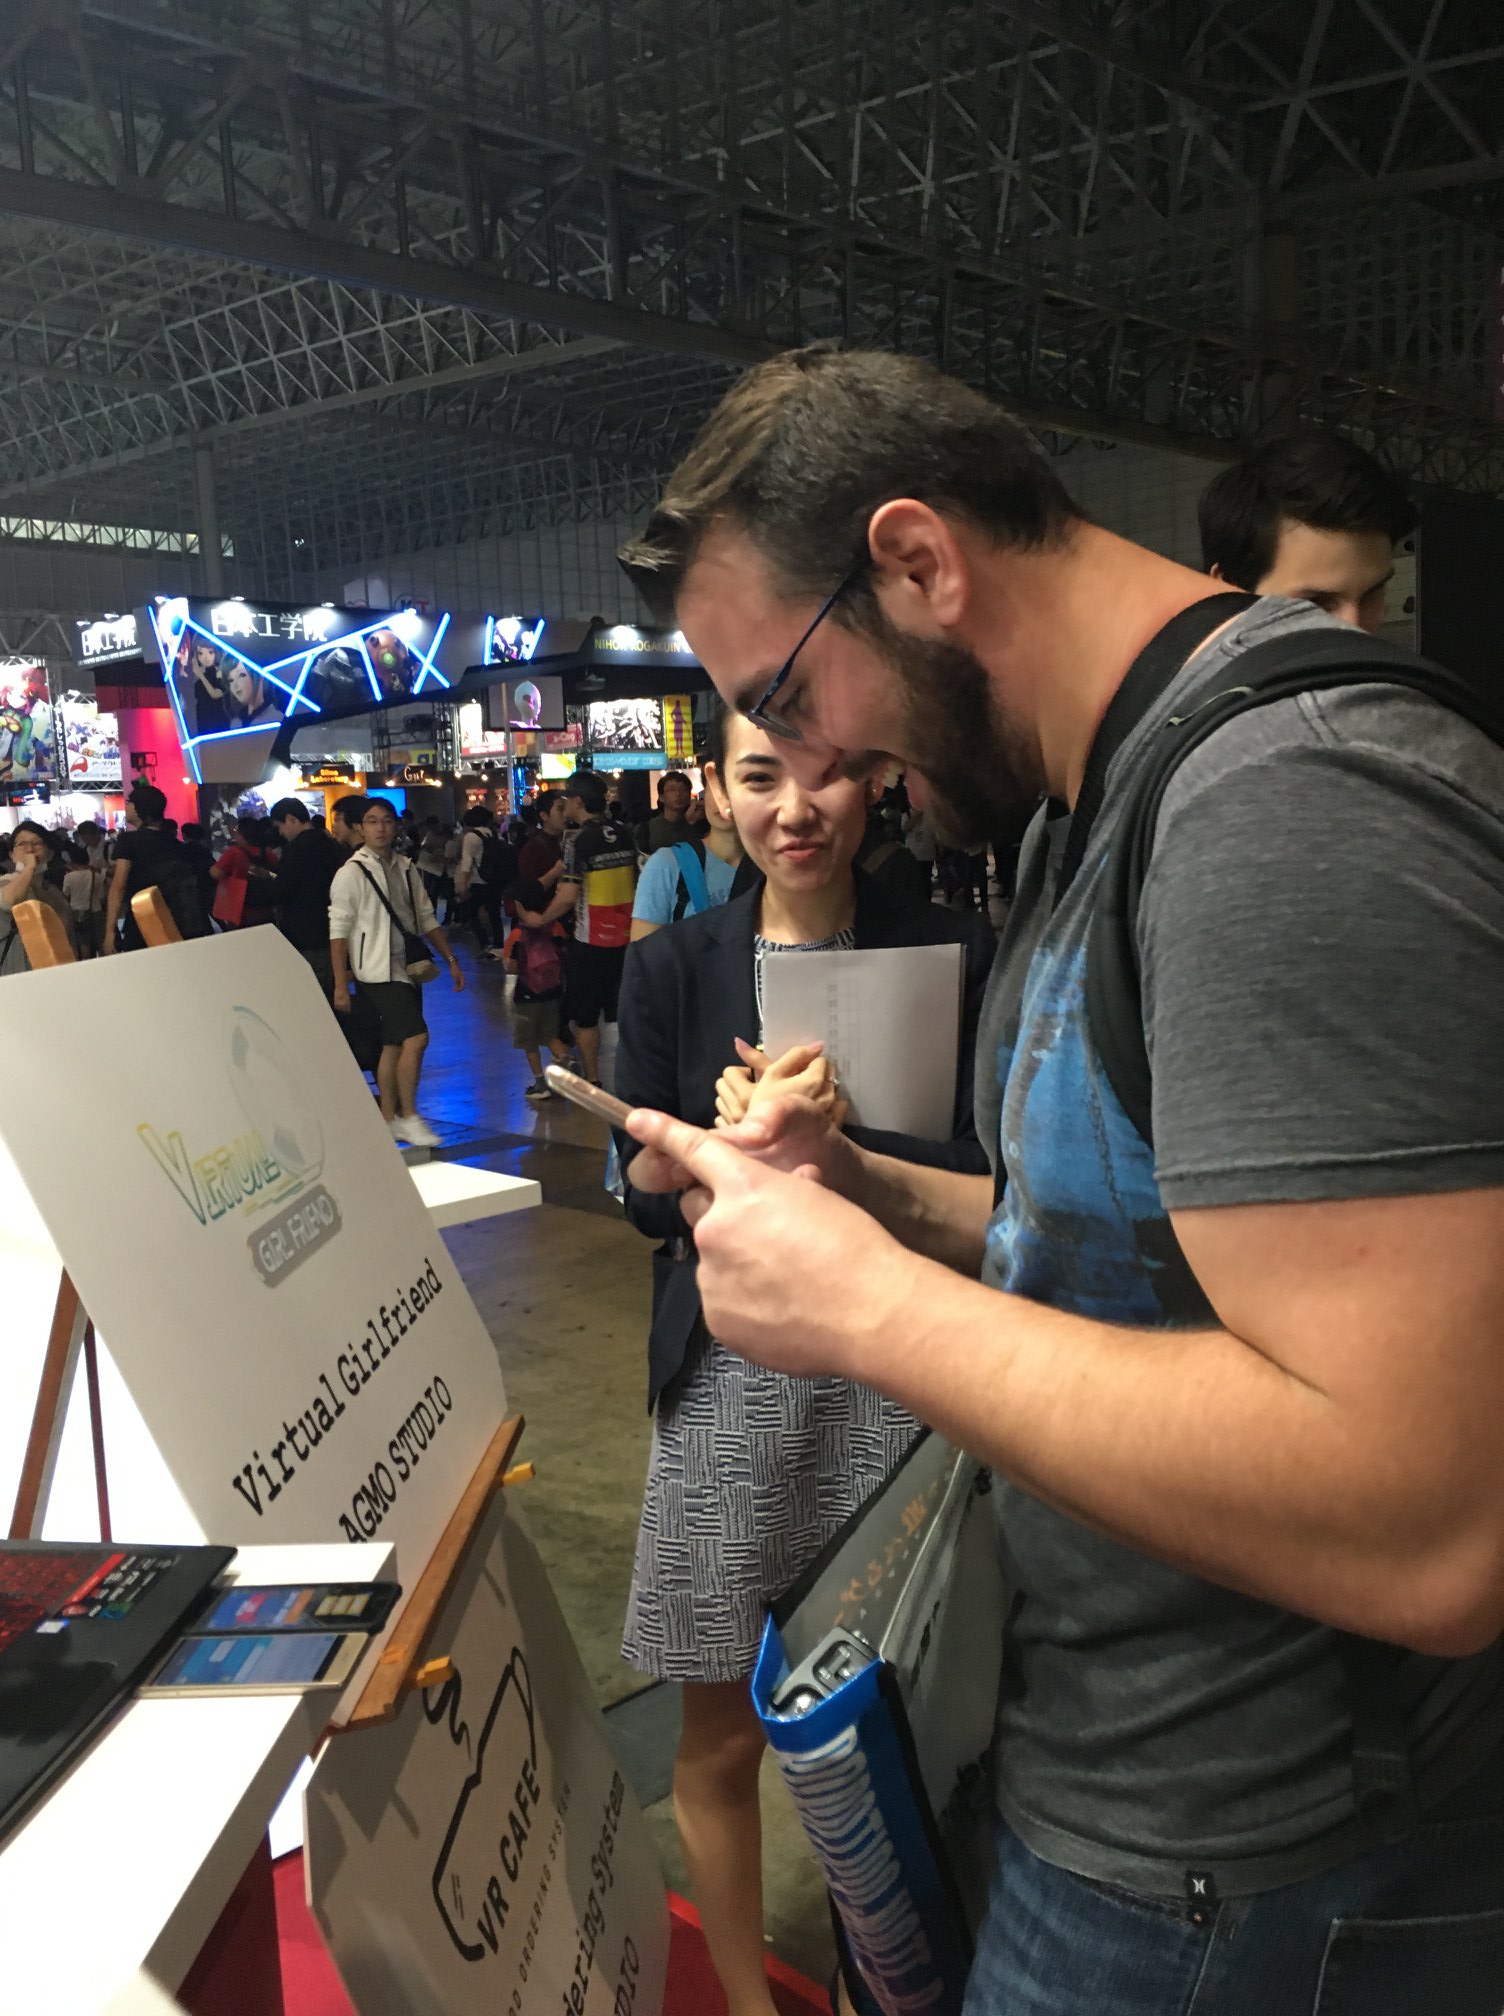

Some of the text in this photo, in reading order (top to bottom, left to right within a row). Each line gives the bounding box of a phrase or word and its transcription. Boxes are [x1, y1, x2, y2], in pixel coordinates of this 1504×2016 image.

[258, 1194, 335, 1273] GIRL FRIEND
[232, 1257, 443, 1516] Virtual Girlfriend
[339, 1375, 453, 1544] AGMO STUDIO
[477, 1758, 541, 1955] VR CAFE
[519, 1864, 551, 1982] ORDERING
